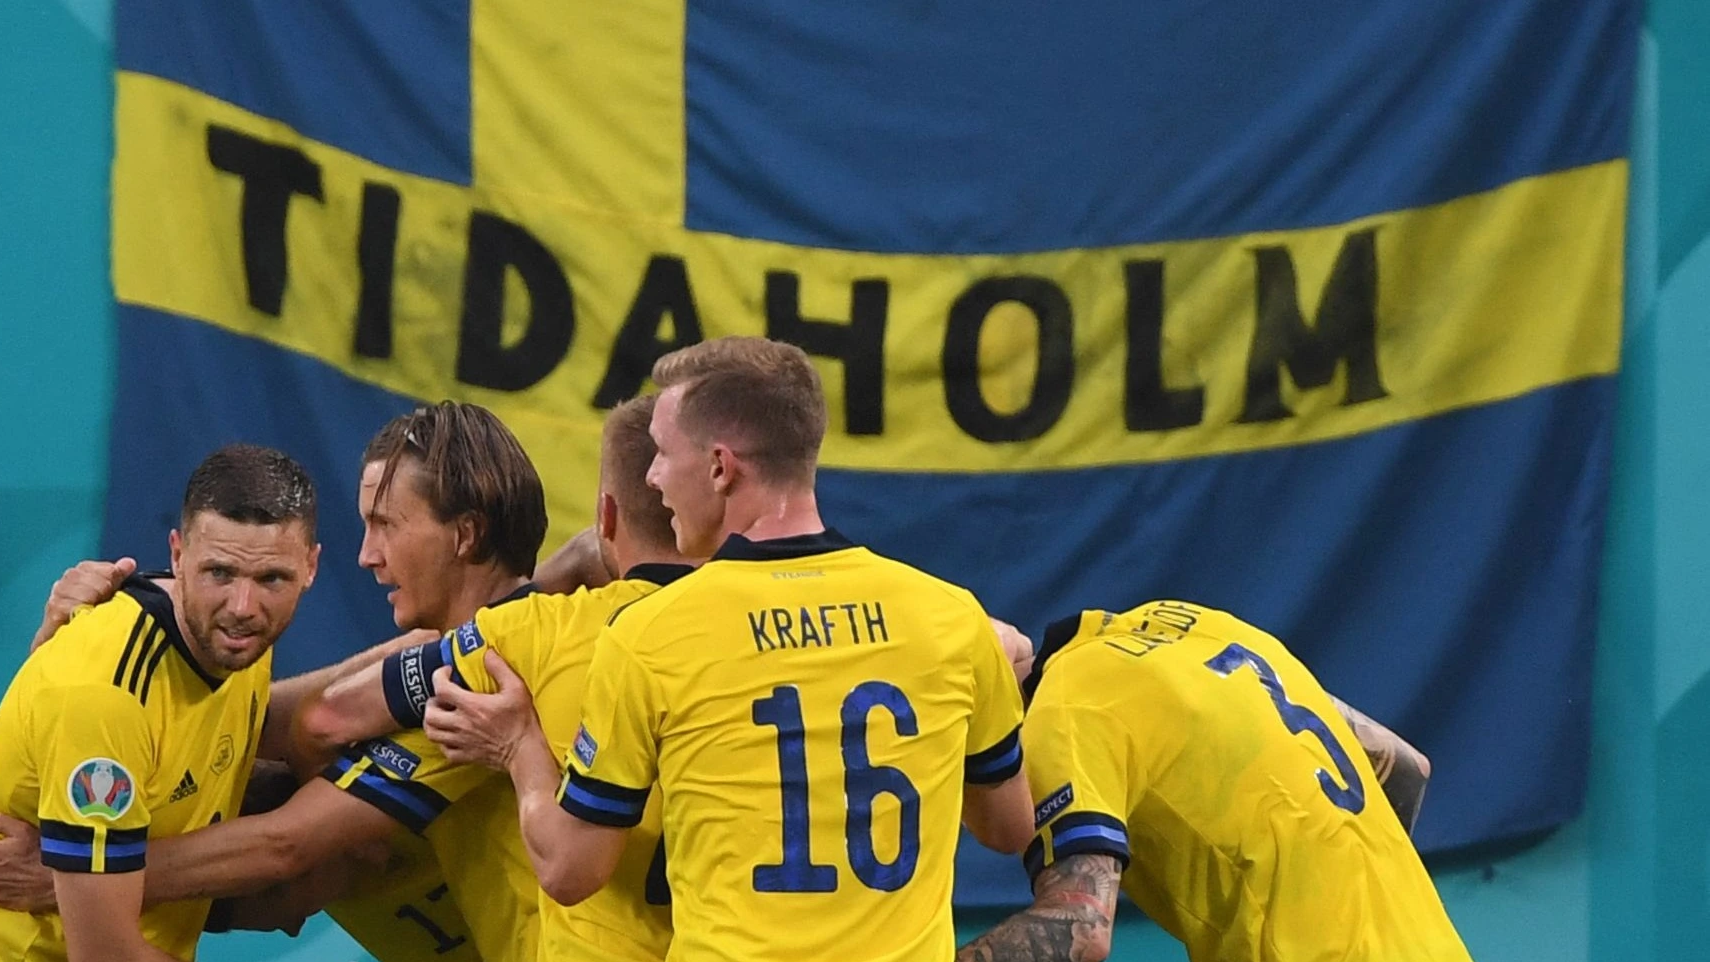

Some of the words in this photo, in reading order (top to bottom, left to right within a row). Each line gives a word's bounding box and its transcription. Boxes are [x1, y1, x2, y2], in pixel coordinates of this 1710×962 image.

[206, 122, 1388, 444] TIDAHOLM
[748, 602, 889, 652] KRAFTH
[404, 657, 428, 713] RESPEC
[371, 743, 417, 773] ESPECT
[1204, 642, 1366, 815] 3
[752, 680, 920, 893] 16
[395, 883, 467, 954] 1
